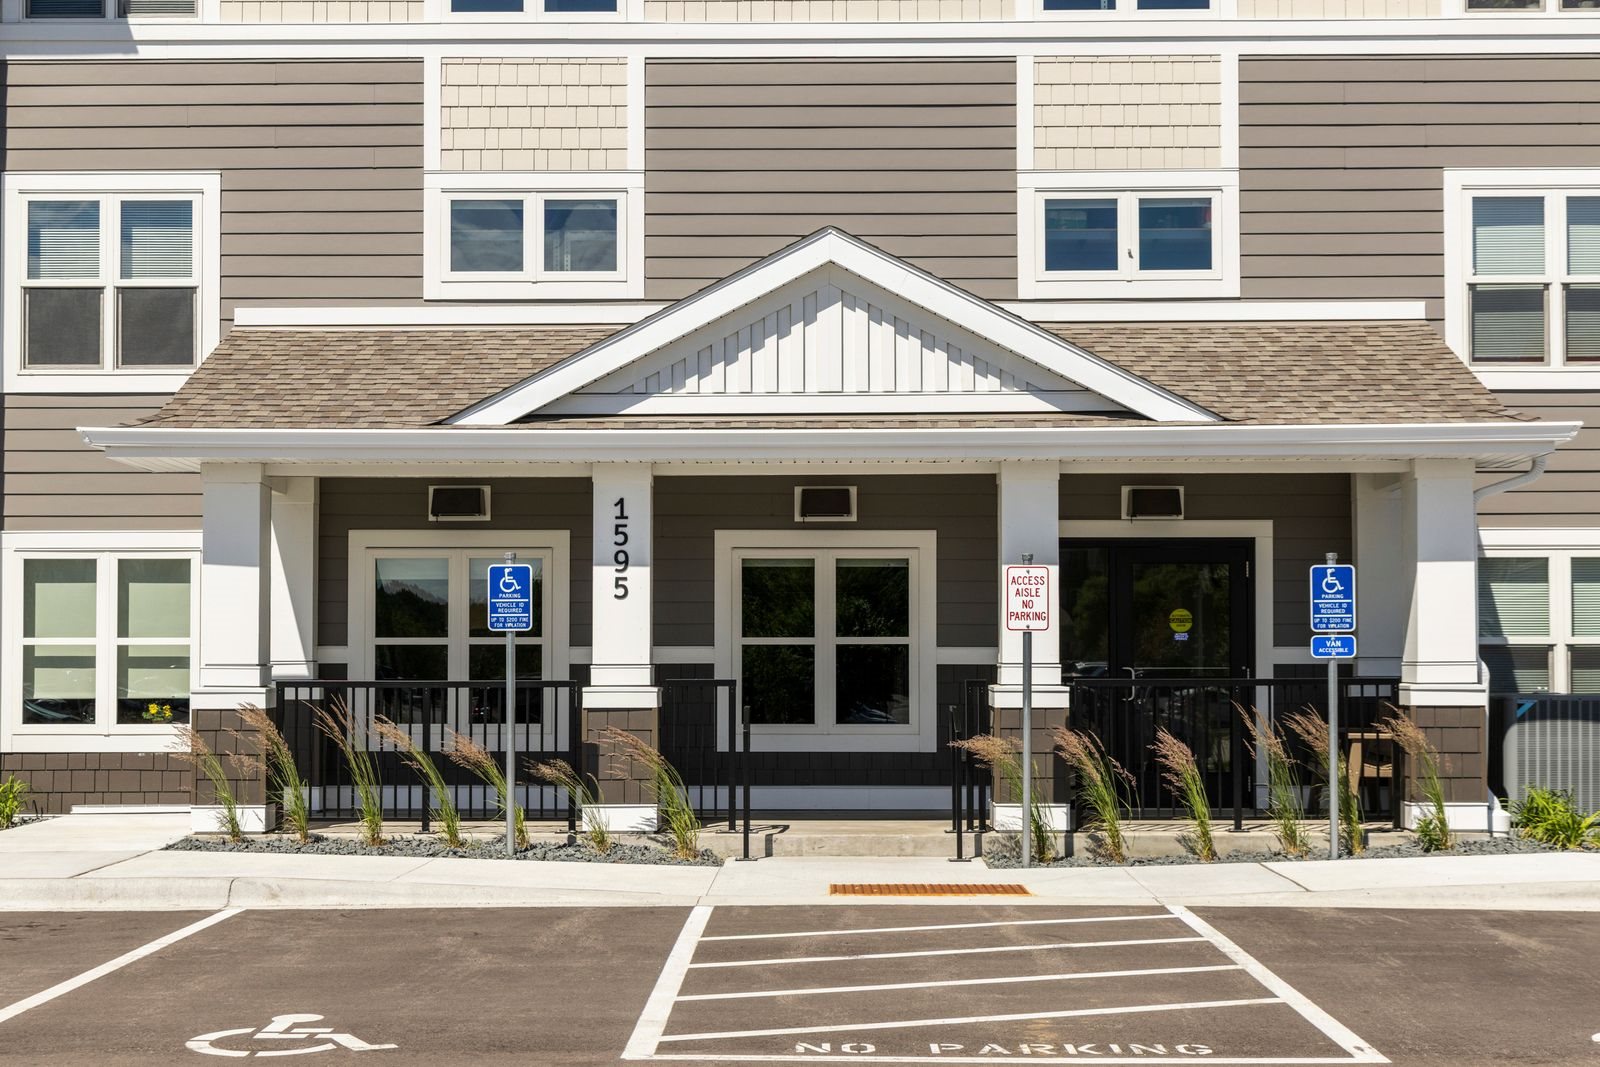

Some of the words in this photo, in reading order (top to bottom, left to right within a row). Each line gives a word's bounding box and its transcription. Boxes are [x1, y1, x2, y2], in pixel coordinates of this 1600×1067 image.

[613, 497, 630, 601] 1595
[1010, 575, 1045, 585] ACCESS
[1015, 587, 1040, 597] AISLE
[1022, 599, 1034, 609] NO
[1009, 611, 1046, 621] PARKING
[795, 1042, 876, 1054] NO
[928, 1042, 1214, 1056] PARKING
